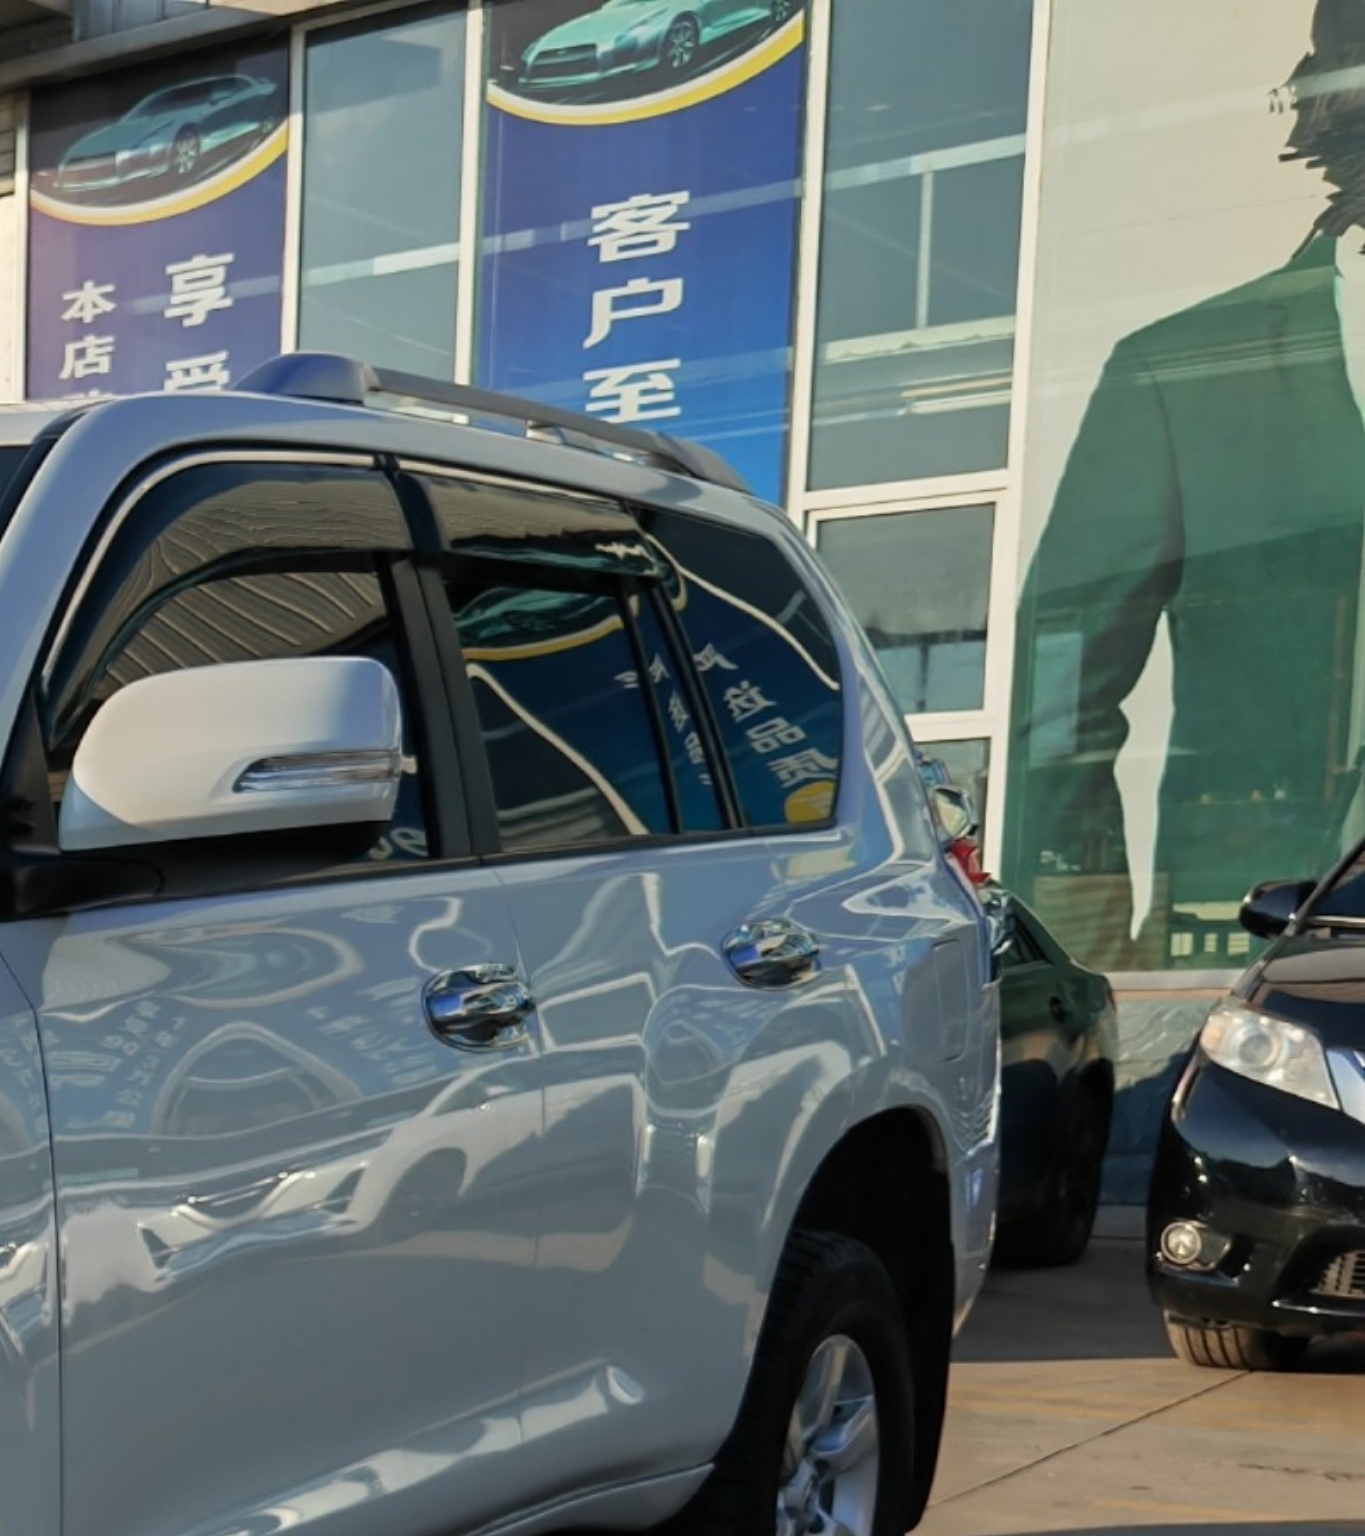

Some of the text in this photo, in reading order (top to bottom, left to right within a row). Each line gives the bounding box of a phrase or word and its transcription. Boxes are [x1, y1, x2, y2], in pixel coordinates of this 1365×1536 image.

[58, 280, 117, 399] 本店
[581, 190, 690, 423] 客户至
